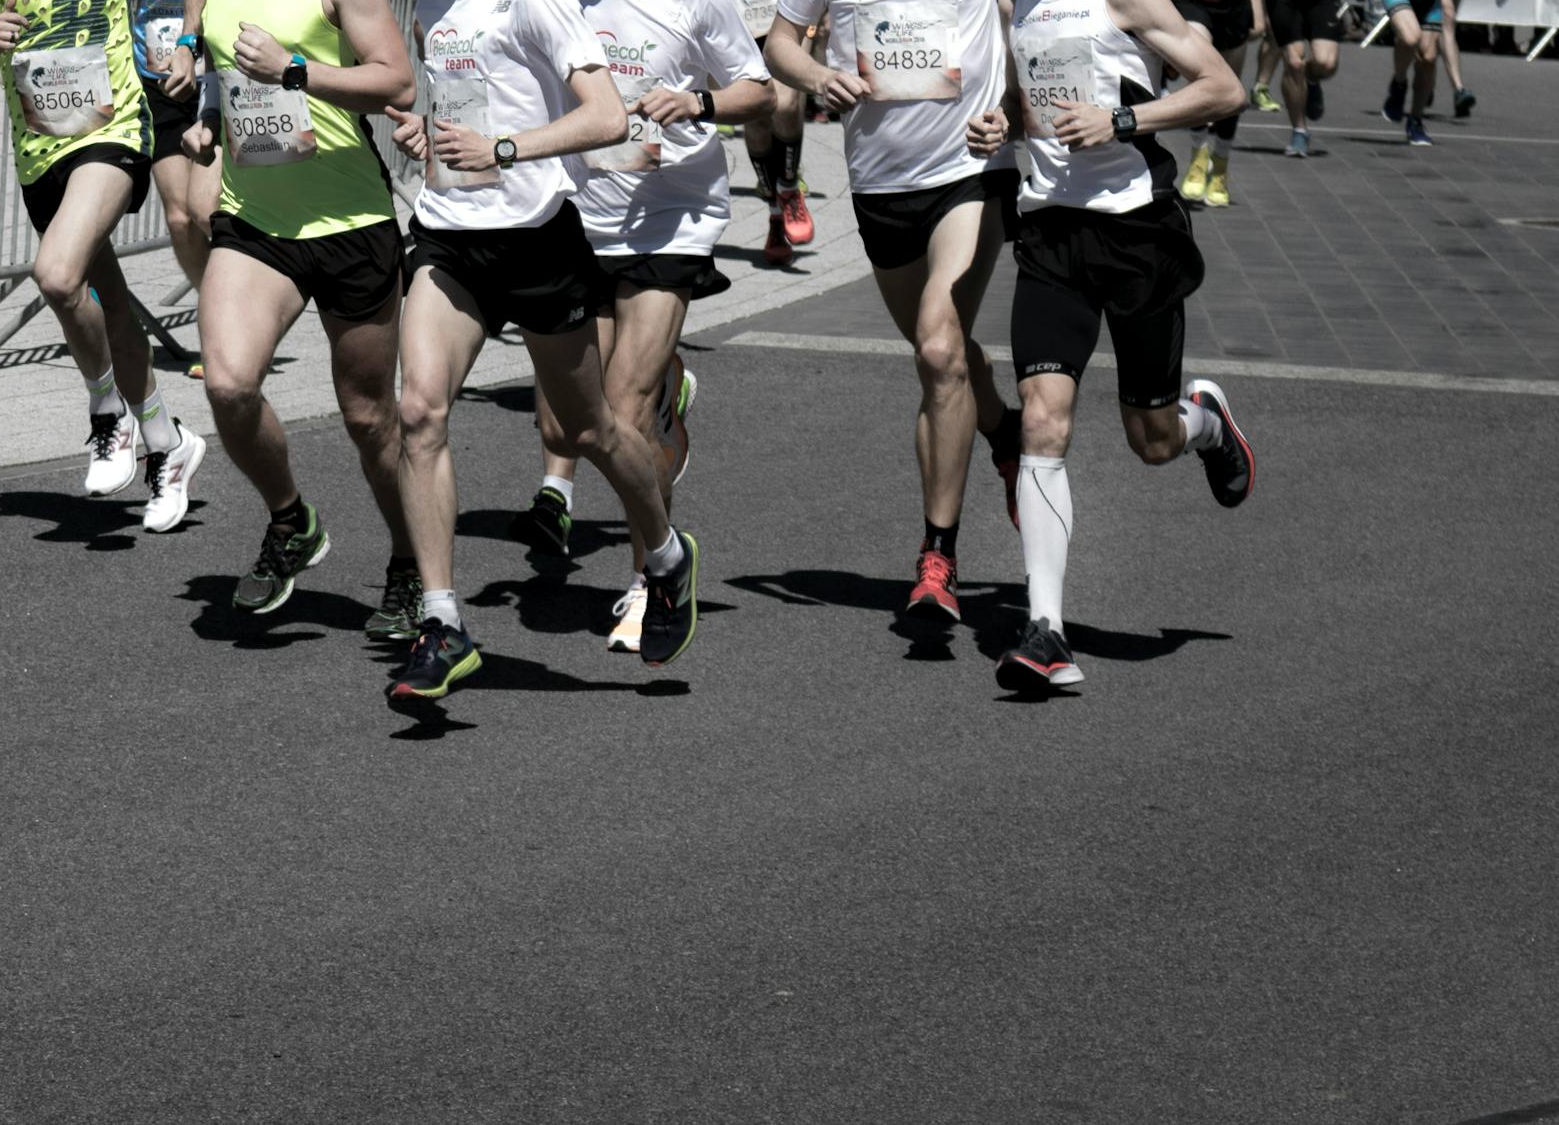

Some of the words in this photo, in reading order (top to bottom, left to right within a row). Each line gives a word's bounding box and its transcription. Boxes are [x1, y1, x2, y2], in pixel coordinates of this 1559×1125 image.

[433, 38, 475, 56] Benecol
[445, 58, 476, 71] team
[874, 49, 943, 70] 84832
[609, 63, 645, 77] eam
[34, 88, 96, 111] 85064
[1029, 86, 1080, 107] 58531
[233, 114, 294, 137] 30858
[241, 141, 290, 154] Sebastian
